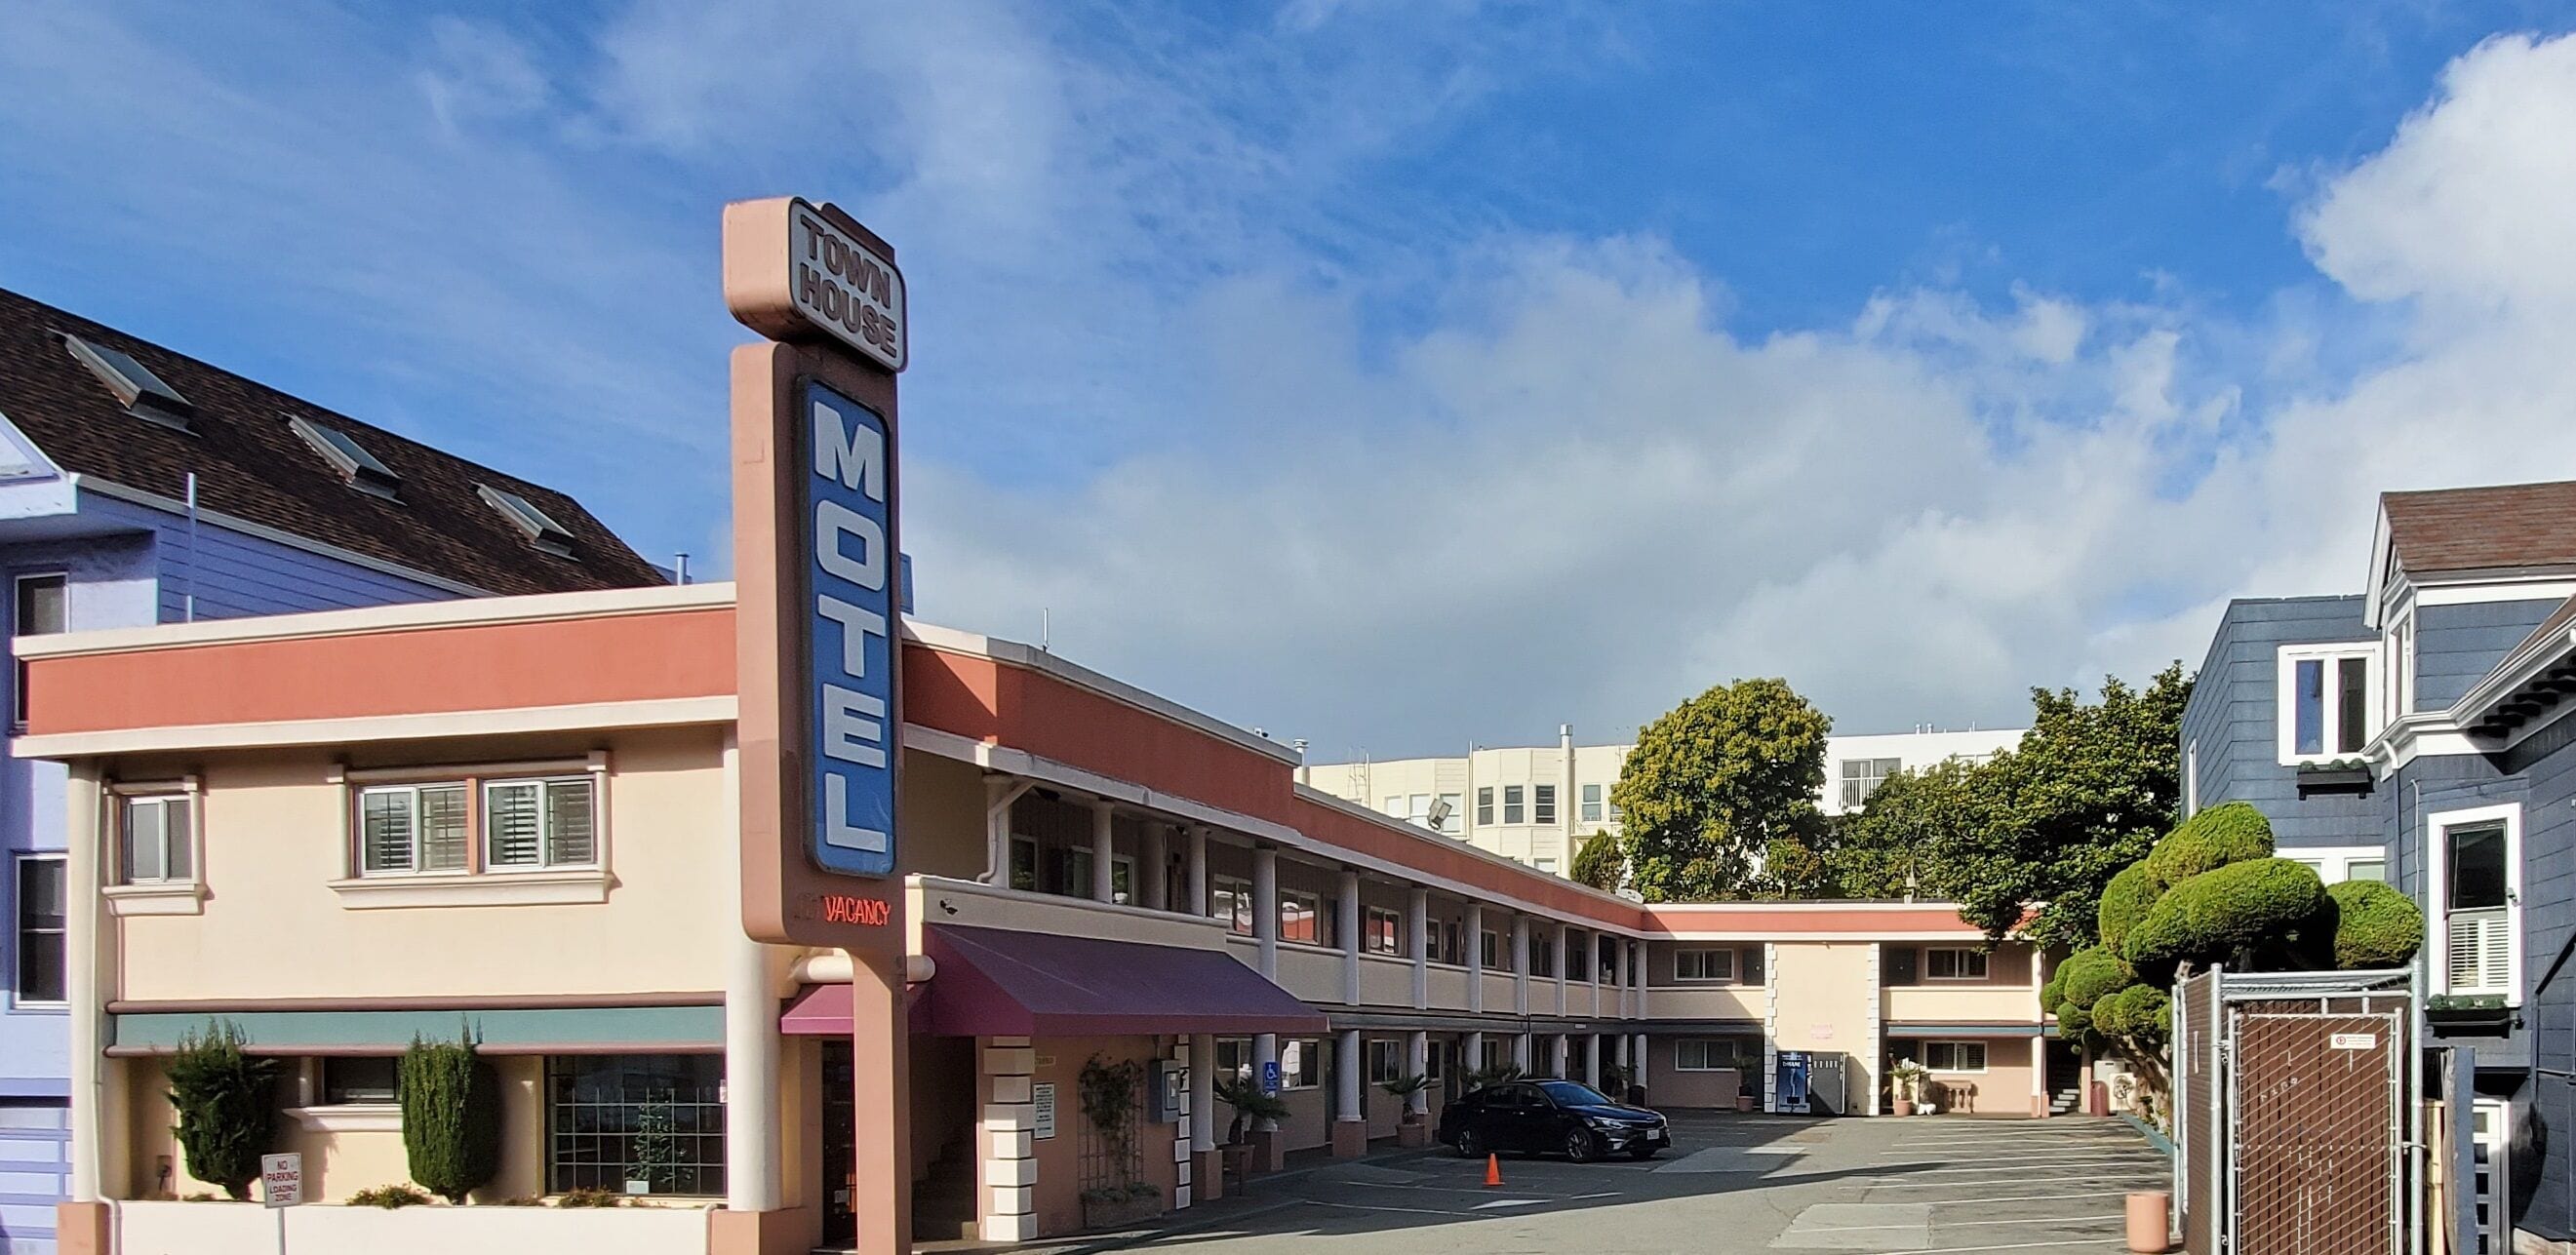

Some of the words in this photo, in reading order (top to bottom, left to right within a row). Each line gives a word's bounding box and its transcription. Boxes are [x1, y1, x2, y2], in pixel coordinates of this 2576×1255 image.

[800, 214, 891, 309] TOWN
[800, 262, 897, 359] HOUSE
[813, 401, 887, 853] MOTEL
[824, 895, 892, 926] VACANCY
[277, 1160, 289, 1170] NO
[266, 1171, 298, 1183] PARKING
[270, 1184, 297, 1194] LOADING
[275, 1193, 292, 1202] ZONE
